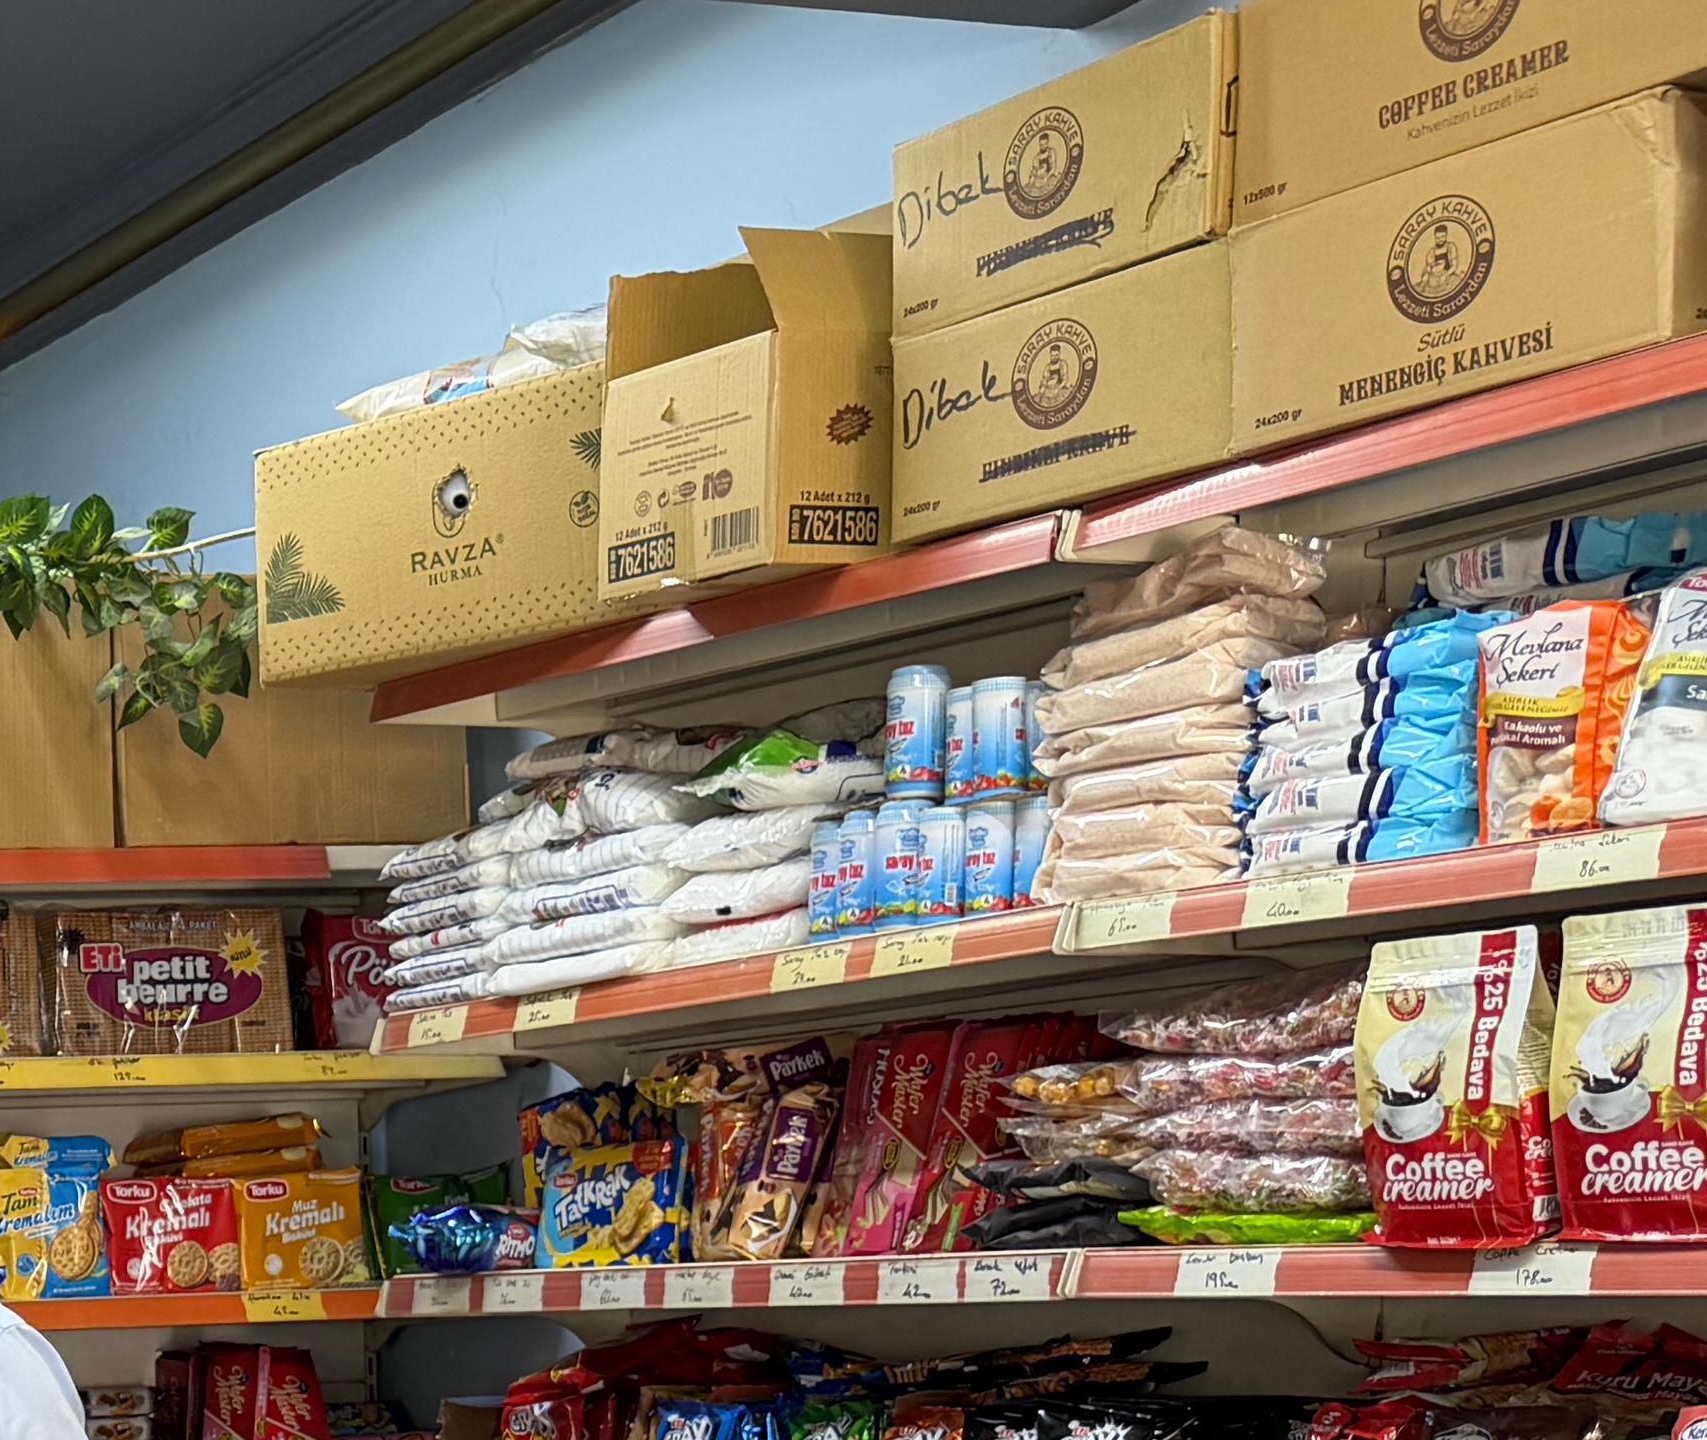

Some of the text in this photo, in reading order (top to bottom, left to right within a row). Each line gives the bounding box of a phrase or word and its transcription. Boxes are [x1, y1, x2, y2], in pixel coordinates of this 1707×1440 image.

[1379, 39, 1569, 129] COFFEE CREAMER
[1407, 95, 1512, 141] Kahvenizin Lezzet
[1393, 201, 1487, 262] SARAY KAHVE
[1393, 262, 1488, 318] Lezzeti Saraydan
[1017, 323, 1092, 374] SARAY KAHVE
[1418, 323, 1465, 353] Sütlü
[1338, 321, 1554, 407] MENENGİÇ KAHVESİ
[1254, 408, 1302, 428] 24x200 gr
[800, 491, 811, 501] 12
[837, 494, 842, 502] x
[844, 492, 862, 503] 212
[864, 494, 870, 504] g
[803, 510, 876, 542] 7621586
[410, 537, 497, 574] RAVZA
[617, 537, 674, 577] 7621586
[428, 565, 483, 586] HURMA
[1488, 622, 1584, 661] Mevlana
[1497, 655, 1557, 688] Şekeri
[134, 955, 210, 980] petit
[118, 979, 227, 1002] beurre
[1465, 1010, 1498, 1101] Bedava
[1386, 1152, 1485, 1180] Coffee
[1585, 1143, 1705, 1172] Coffee
[1, 1194, 39, 1211] Tam
[114, 1186, 151, 1197] Torku
[251, 1185, 285, 1196] Torku
[1384, 1177, 1494, 1201] creamer
[266, 1203, 344, 1237] Kremalı
[292, 1200, 317, 1211] Muz
[125, 1211, 211, 1240] Kremalı
